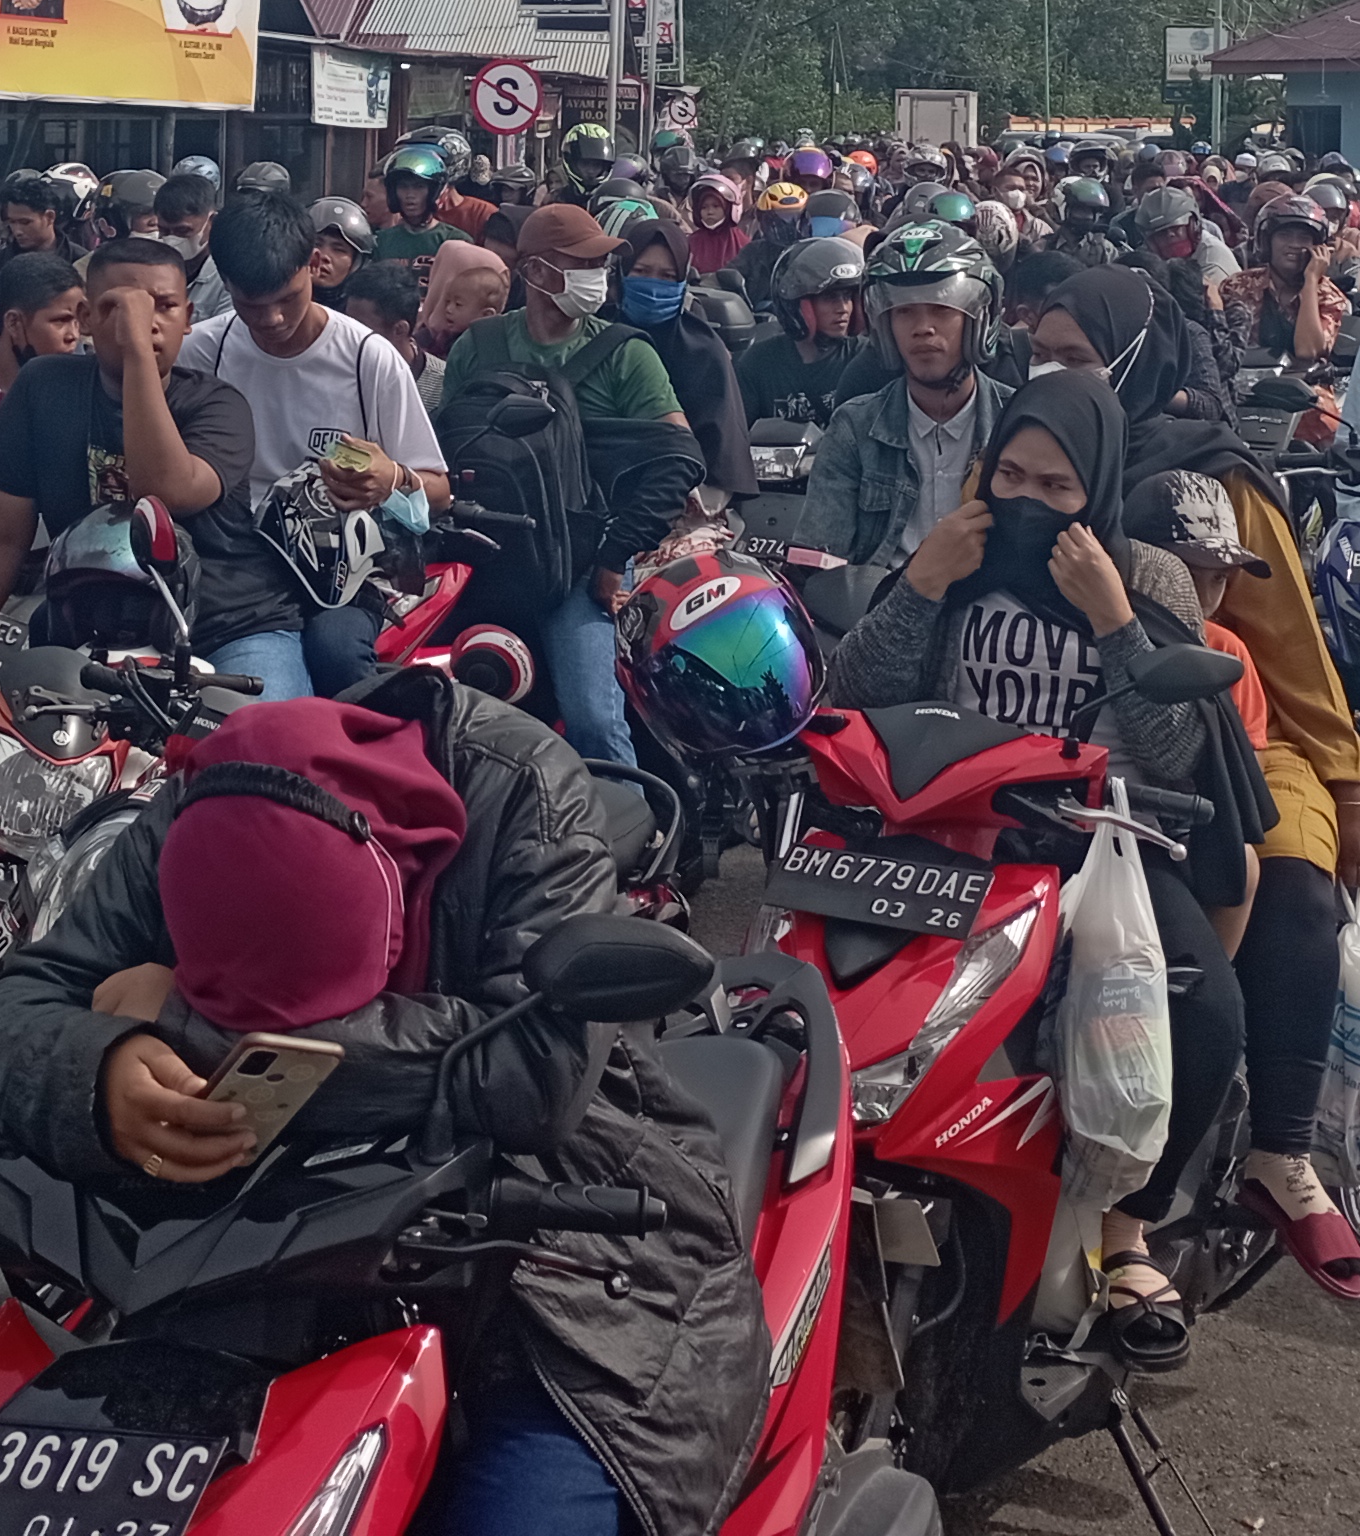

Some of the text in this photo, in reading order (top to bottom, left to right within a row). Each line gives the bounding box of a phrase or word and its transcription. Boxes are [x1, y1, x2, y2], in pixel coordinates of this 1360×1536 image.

[1169, 54, 1189, 65] JASA
[566, 99, 637, 111] AYAM PYET
[748, 537, 785, 556] 3774
[685, 583, 726, 615] GM
[962, 604, 1099, 677] MOVE
[192, 716, 221, 731] HON
[914, 707, 960, 721] HONDA
[784, 846, 986, 904] BM 6779 DAE
[870, 898, 963, 931] 03 26
[934, 1096, 994, 1149] HONDA
[132, 1442, 209, 1503] SC
